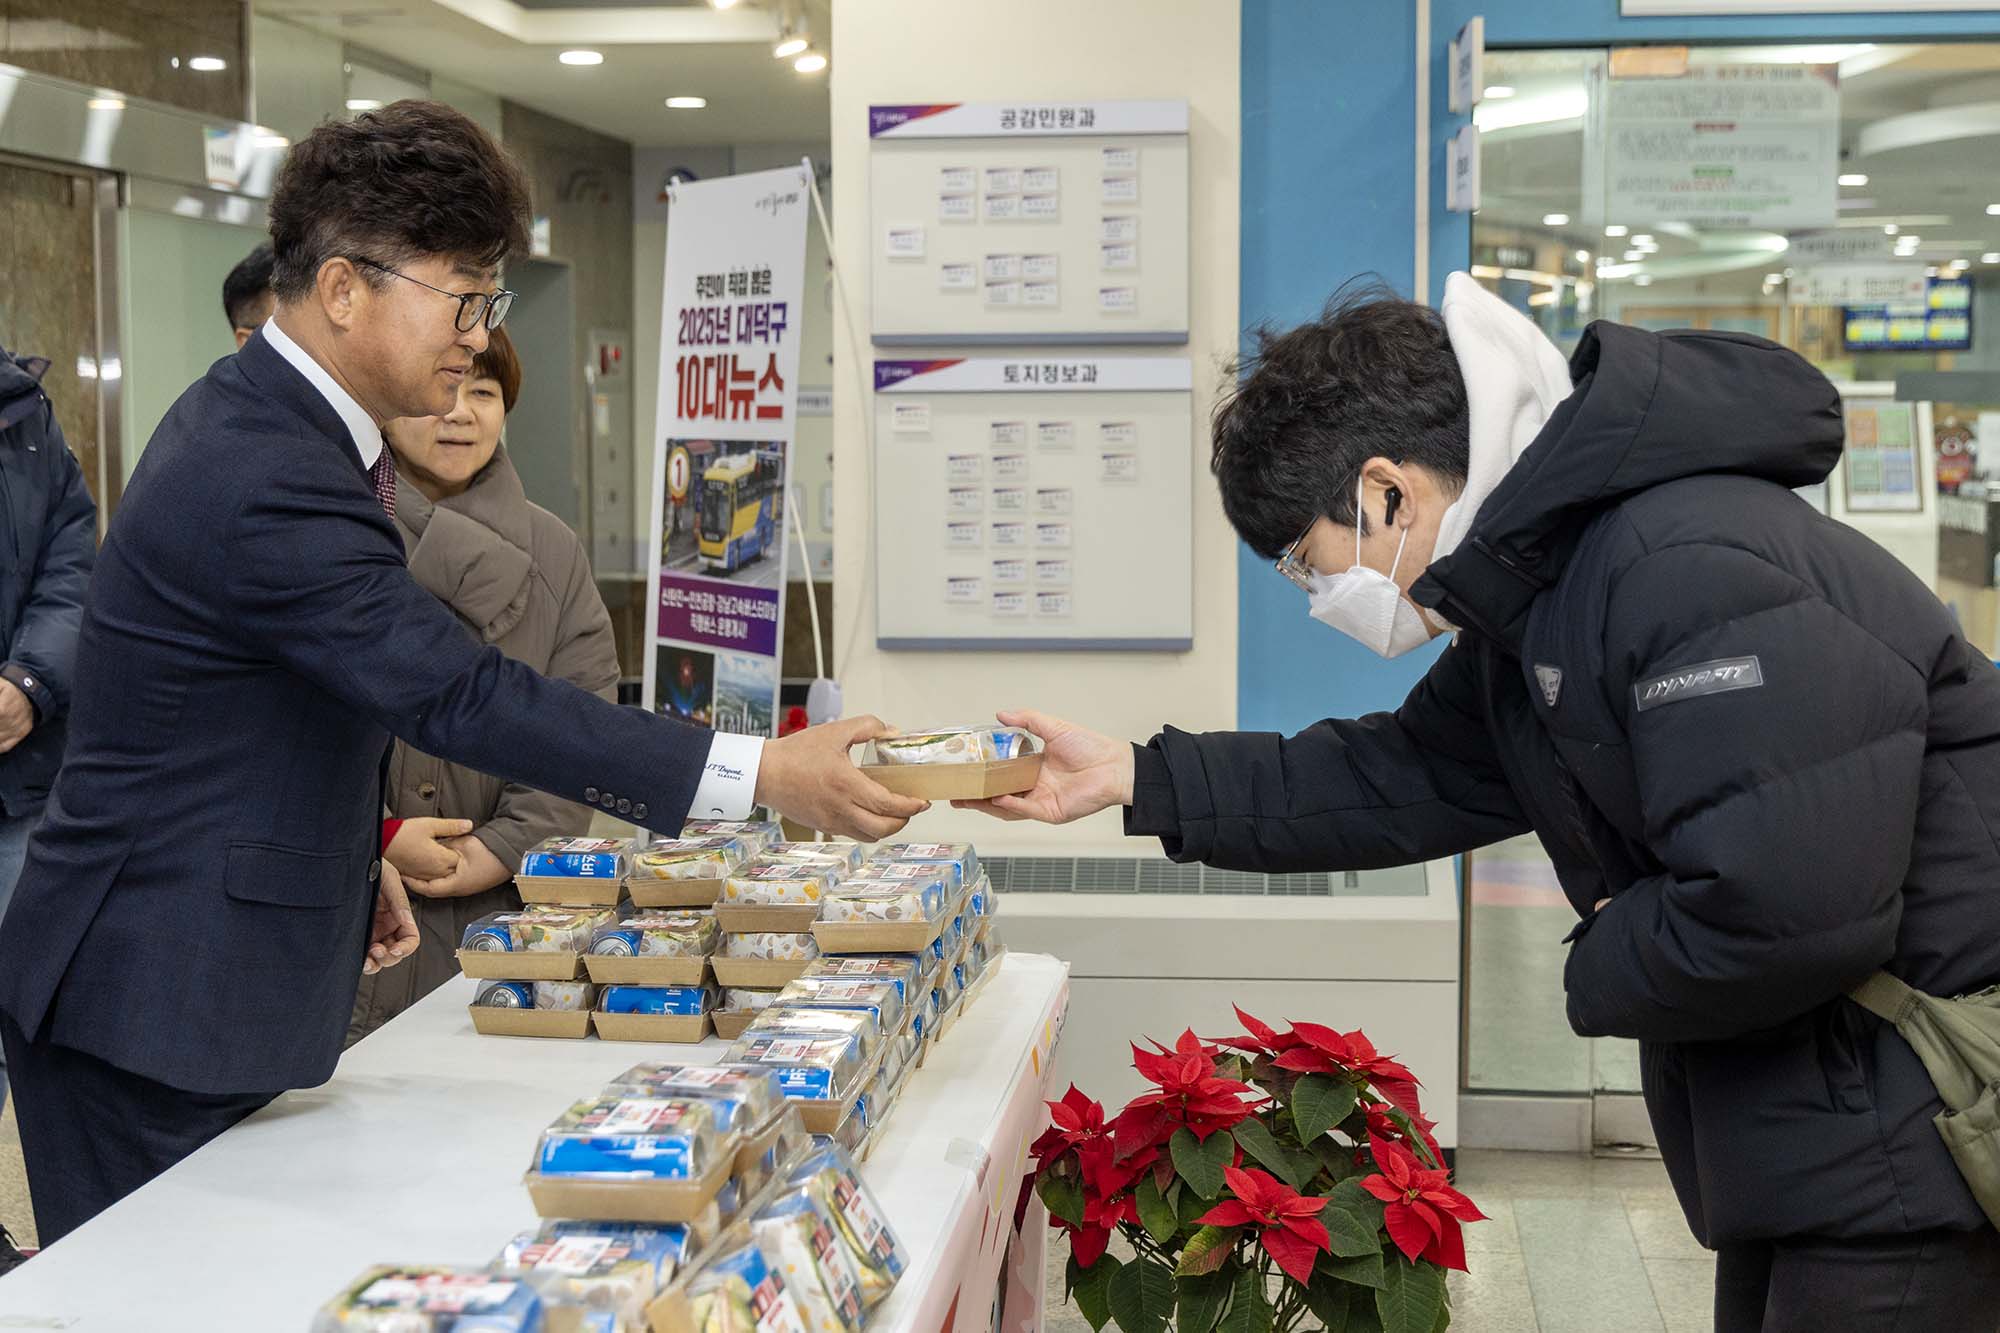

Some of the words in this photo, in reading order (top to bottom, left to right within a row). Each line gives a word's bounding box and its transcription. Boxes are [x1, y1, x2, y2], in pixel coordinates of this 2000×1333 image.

[697, 274, 725, 299] 주민이
[728, 271, 748, 297] 직접
[752, 268, 771, 295] 뽑은
[679, 306, 731, 345] 2025년
[737, 302, 787, 344] 대덕구
[677, 352, 784, 420] 10대뉴스
[1003, 363, 1097, 384] 토지정보과
[675, 458, 683, 487] 1
[1643, 664, 1750, 700] DYNAFIT
